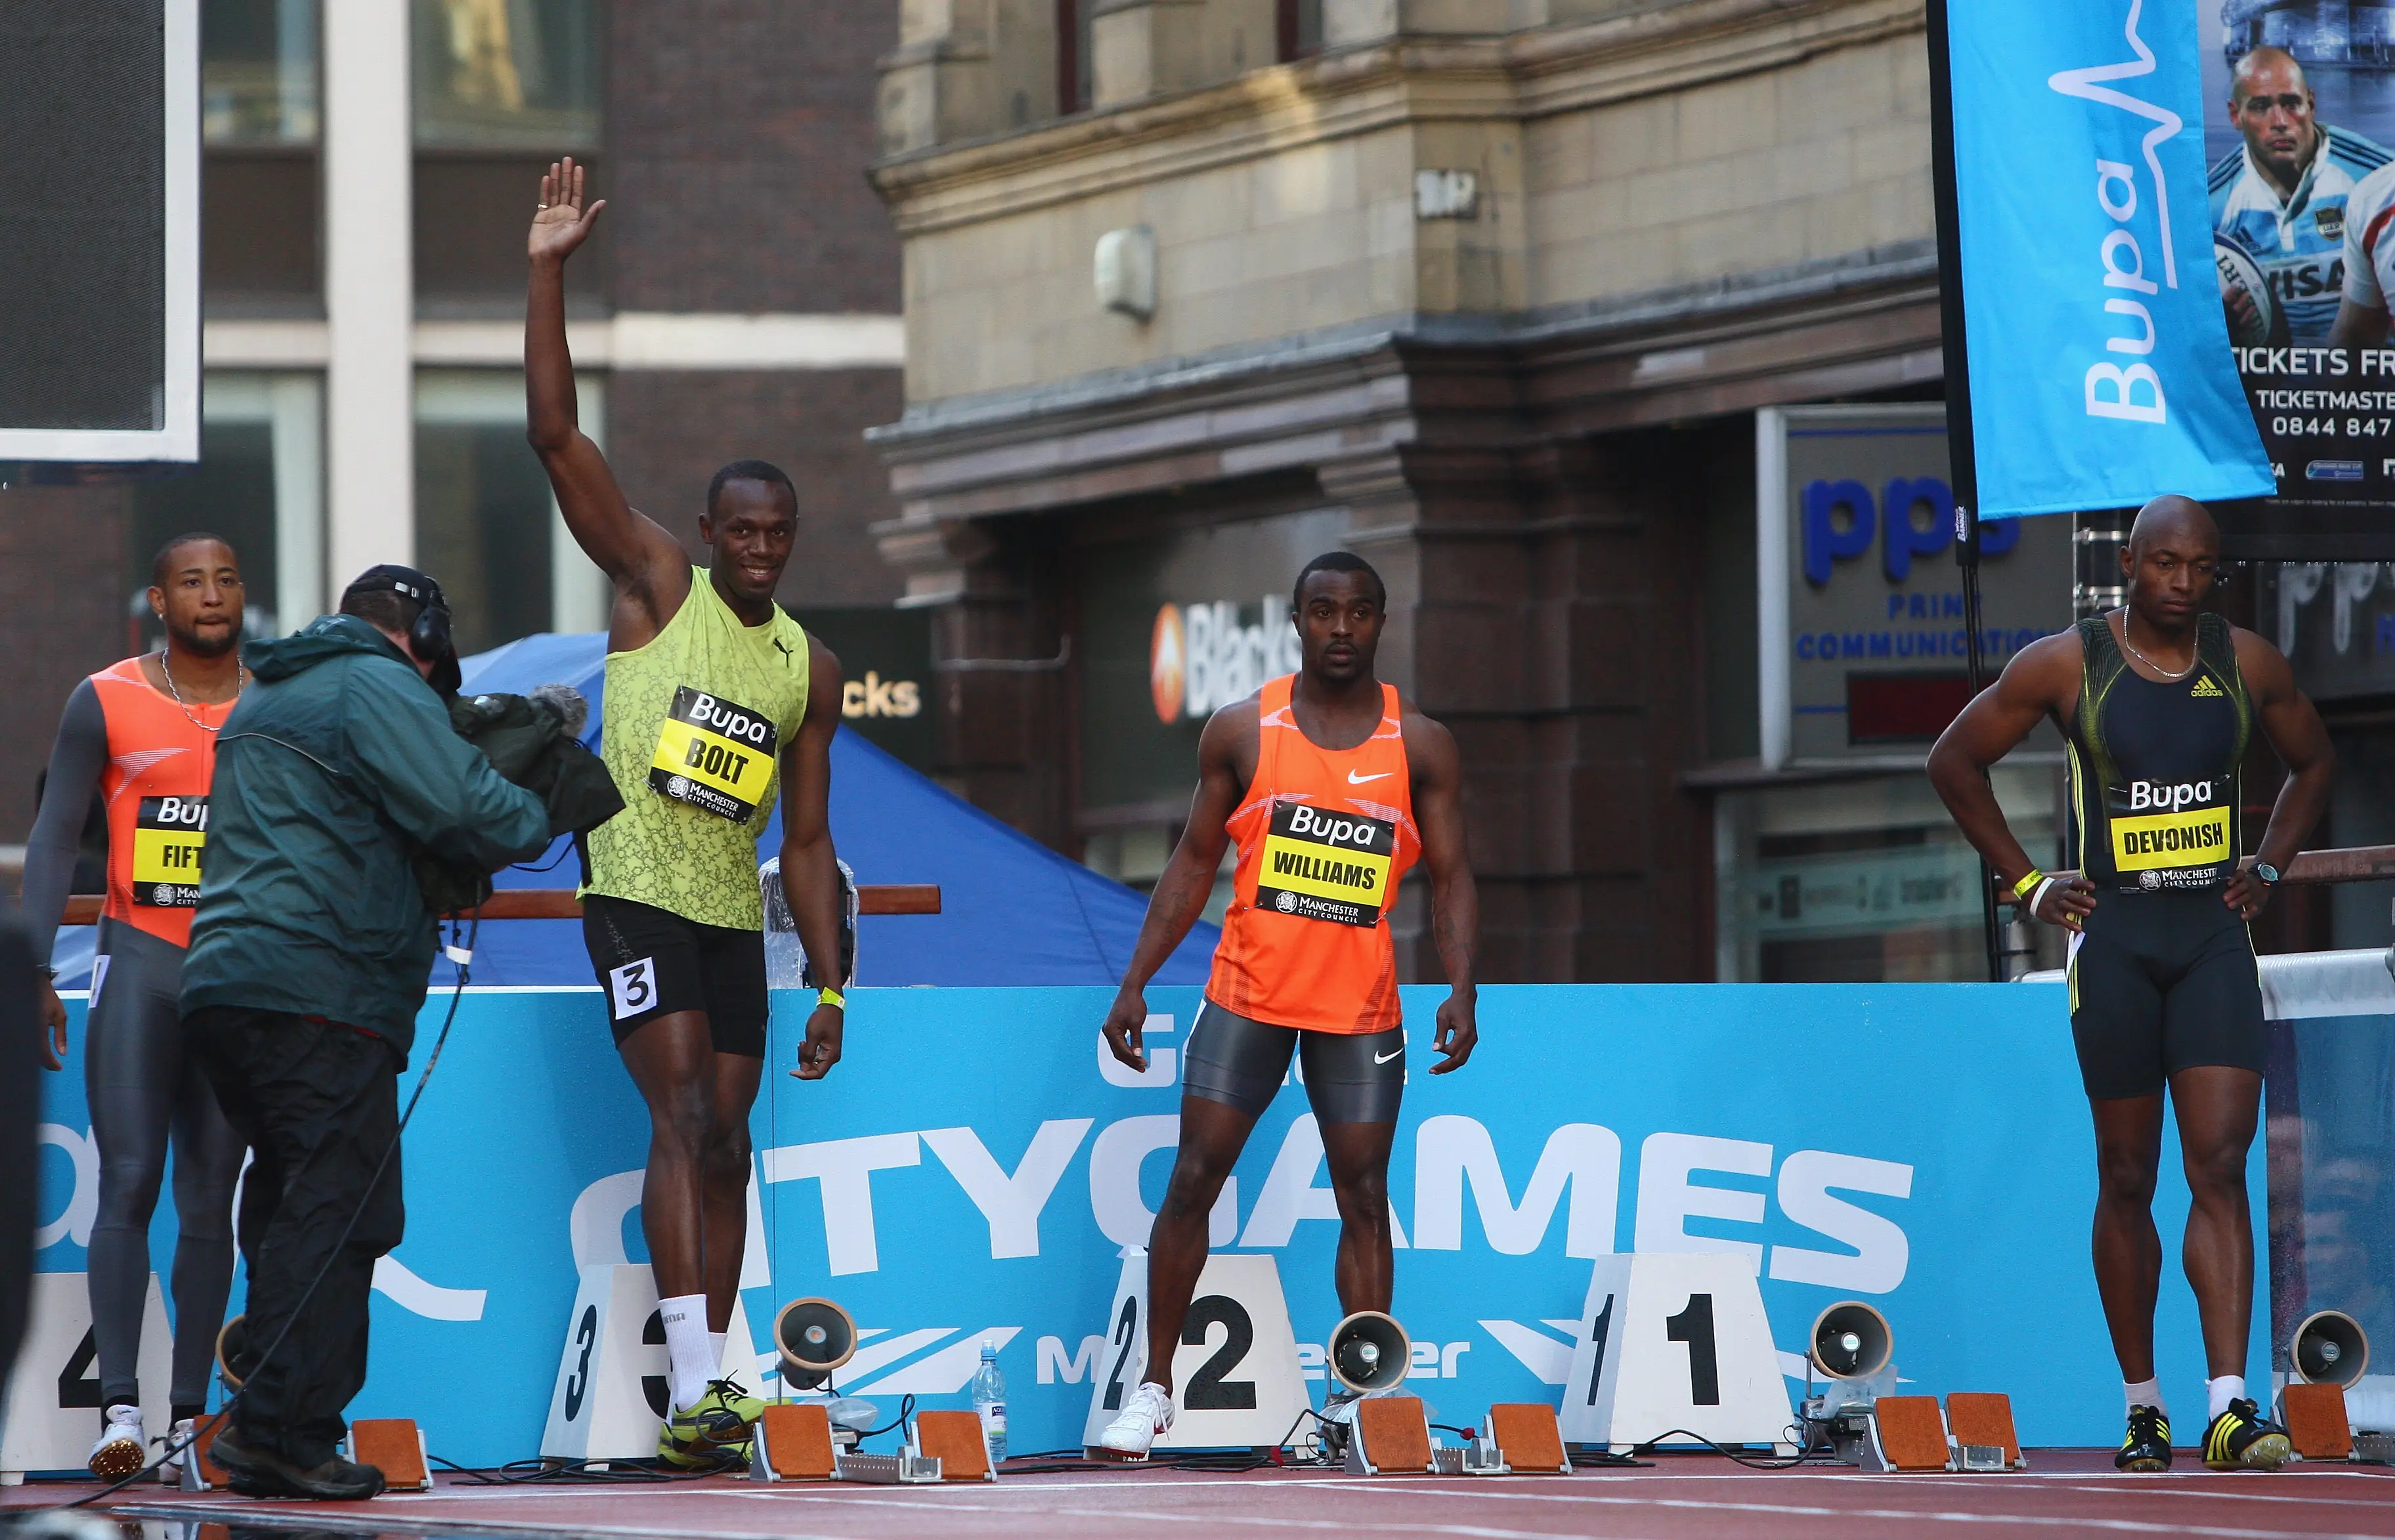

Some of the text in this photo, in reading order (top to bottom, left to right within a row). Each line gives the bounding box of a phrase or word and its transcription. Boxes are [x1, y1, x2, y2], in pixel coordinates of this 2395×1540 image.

[2085, 159, 2166, 424] Bupa
[2272, 416, 2392, 437] 0844 847
[2279, 562, 2395, 656] pp
[1796, 628, 2053, 659] COMMUNICTIO
[2191, 688, 2224, 697] adidas
[689, 693, 767, 744] Bupa
[683, 737, 750, 785] BOLT
[687, 794, 736, 818] CITY COUNCIL
[689, 782, 739, 812] MANCHESTER
[2130, 780, 2212, 813] Bupa
[1289, 805, 1376, 845] Bupa
[2123, 822, 2224, 855] DEVONISH
[1273, 850, 1377, 890] WILLIAMS
[1298, 908, 1358, 924] CITY COUNCIL
[1299, 895, 1359, 917] MANCHESTER
[622, 963, 649, 1007] 3
[565, 1304, 597, 1422] 3
[1102, 1294, 1136, 1411] 2
[1180, 1294, 1257, 1410] 2
[1586, 1293, 1614, 1406] 1
[1666, 1293, 1720, 1405] 1
